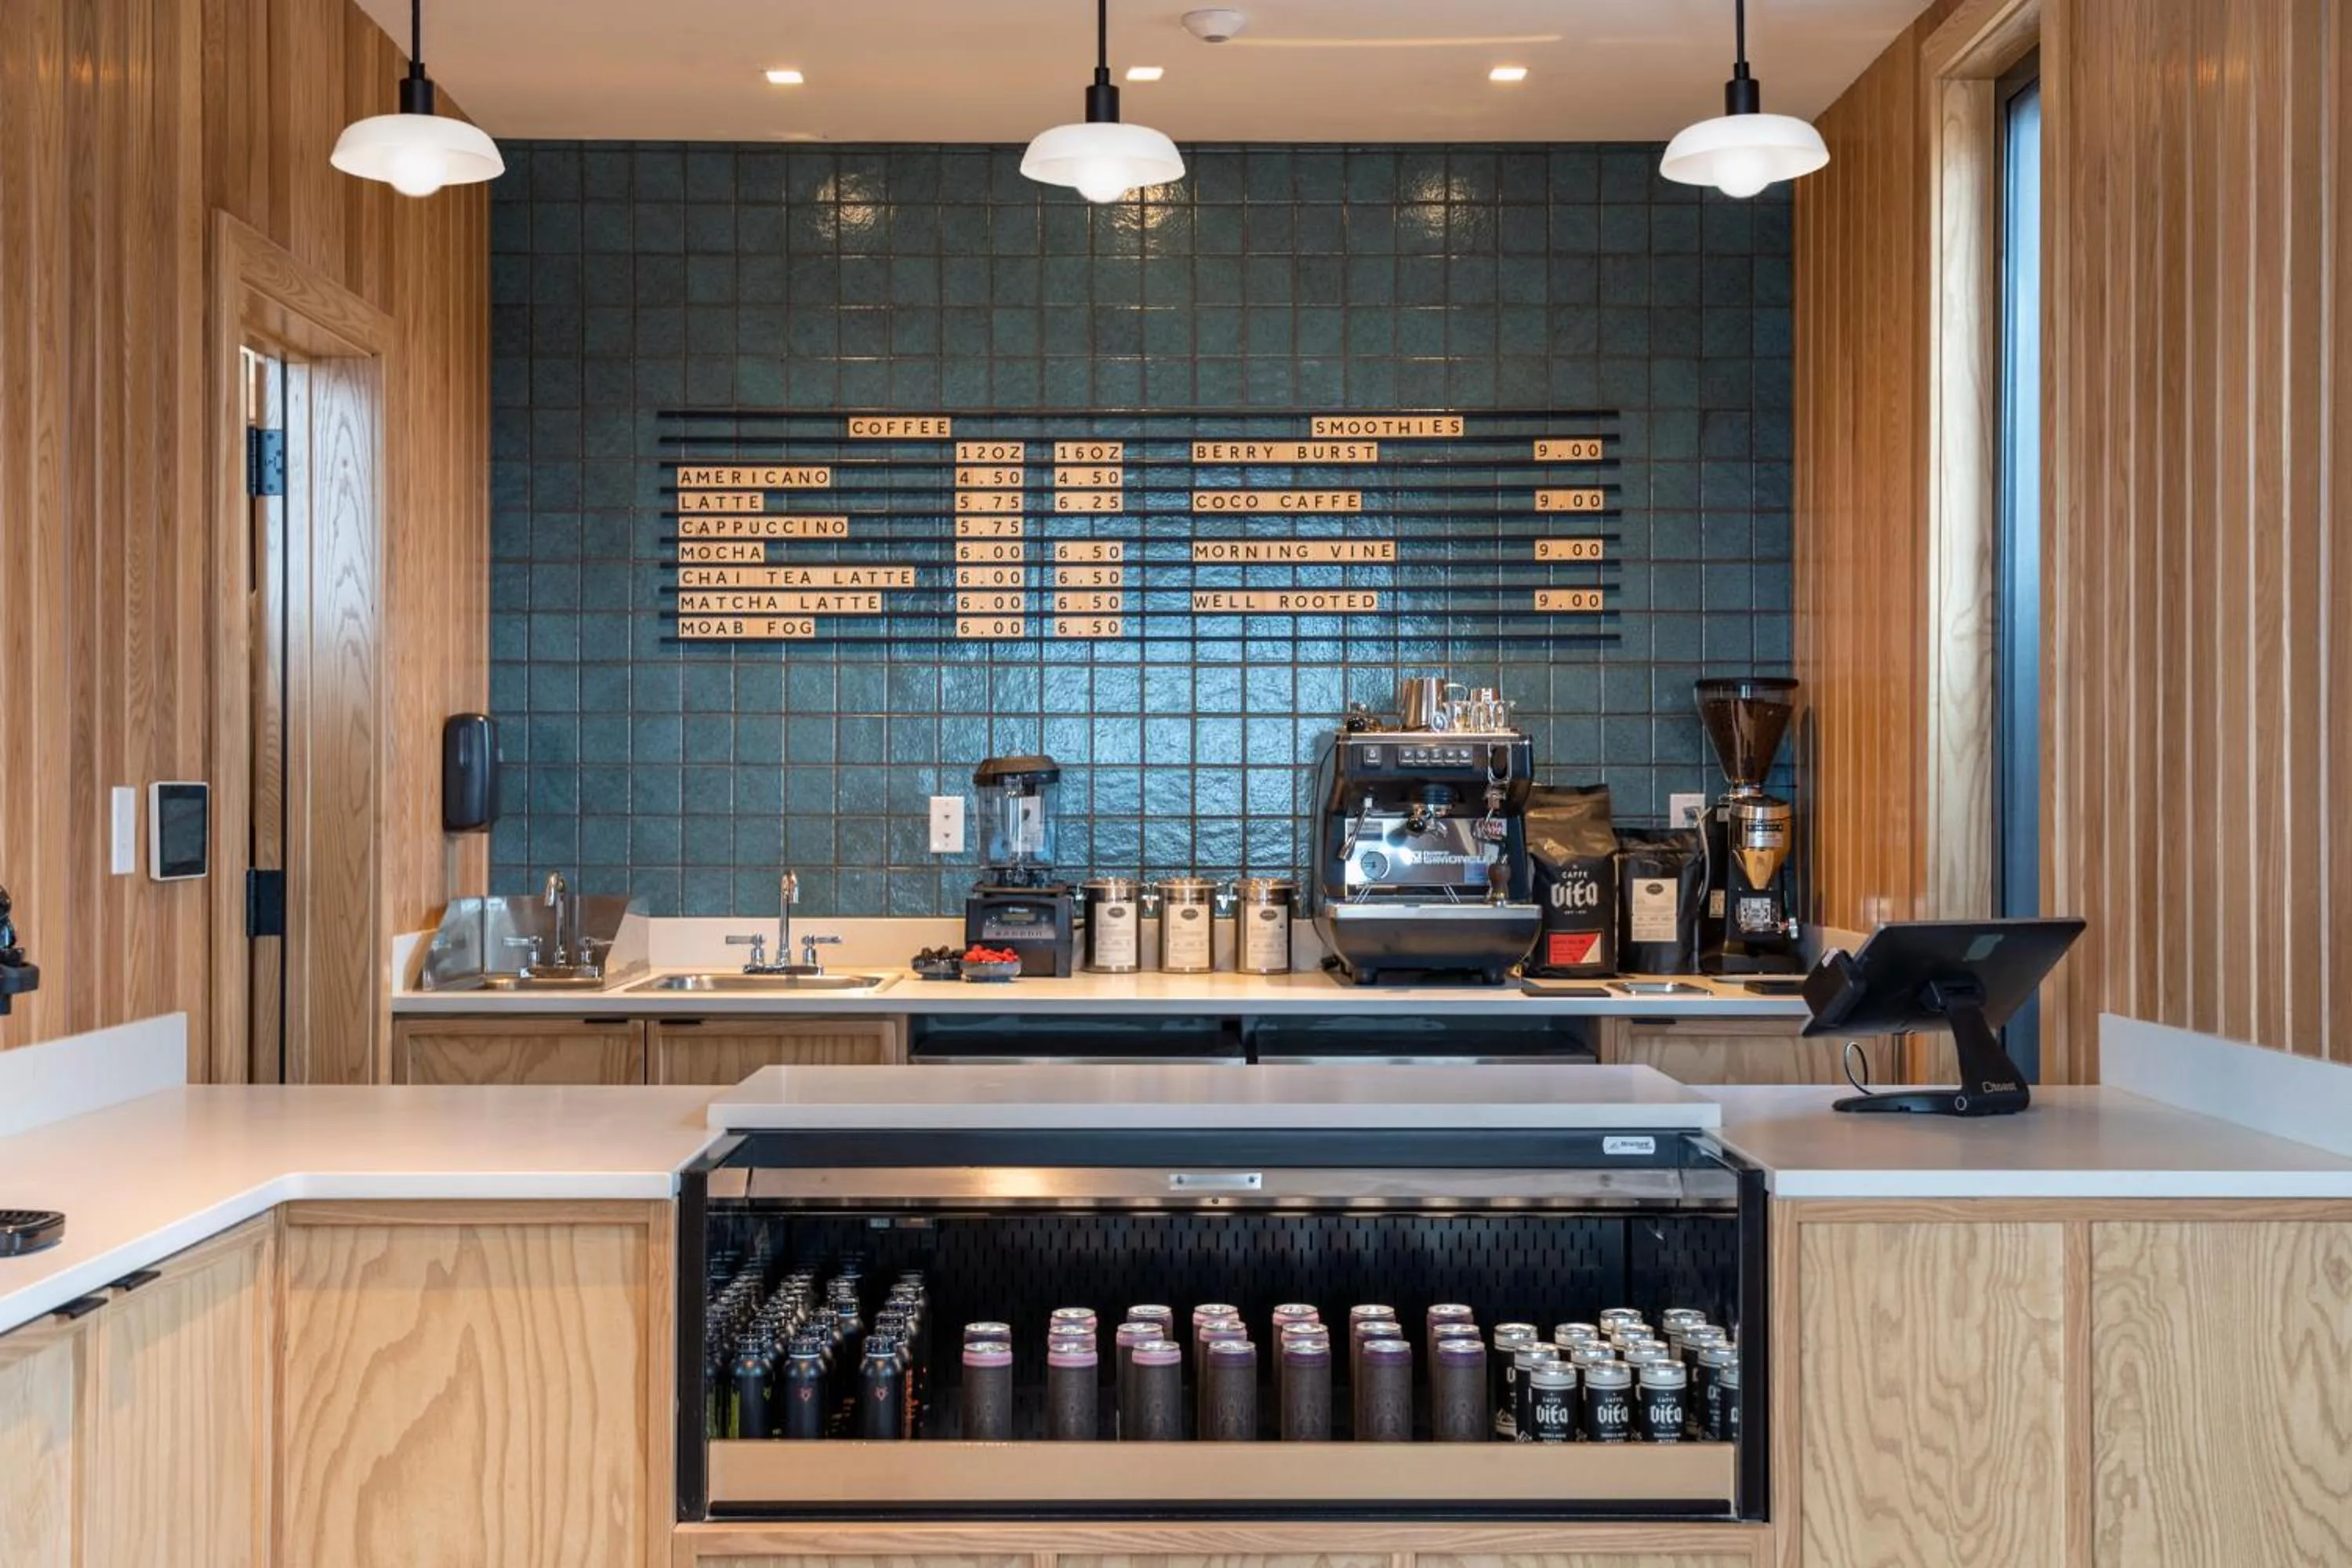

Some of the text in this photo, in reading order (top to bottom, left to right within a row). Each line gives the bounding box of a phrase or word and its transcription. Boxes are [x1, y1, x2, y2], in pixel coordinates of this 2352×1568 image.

[852, 420, 947, 436] COFFEE
[1316, 419, 1460, 435] SMOOTHIES
[960, 445, 1021, 460] 12OZ
[1059, 445, 1120, 460] 16OZ
[1196, 445, 1374, 459] BERRY BURST
[1538, 443, 1599, 459] 9.00
[680, 470, 828, 485] AMERICANO
[959, 470, 1020, 485] 4.50
[1058, 470, 1119, 485] 4.50
[681, 495, 759, 510] LATTE
[959, 495, 1019, 510] 5.75
[1059, 495, 1119, 510] 6.25
[1195, 494, 1358, 510] COCO CAFFE
[1540, 494, 1601, 509] 9.00
[681, 520, 845, 535] CAPPUCCINO
[960, 520, 1019, 535] 5.75
[681, 545, 761, 561] MOCHA
[960, 545, 1021, 559] 6.00
[1058, 545, 1120, 561] 6.50
[1194, 543, 1391, 559] MORNING VINE
[1539, 543, 1600, 557] 9.00
[682, 570, 910, 585] CHAI TEA LATTE
[960, 570, 1021, 585] 6.00
[1058, 571, 1120, 585] 6.50
[681, 595, 877, 610] MATCHA LATTE
[960, 595, 1021, 610] 6.00
[1058, 595, 1119, 610] 6.50
[1192, 593, 1374, 609] WELL ROOTED
[1539, 593, 1599, 608] 9.00
[681, 620, 812, 635] MOAB FOG
[960, 620, 1021, 635] 6.00
[1058, 620, 1119, 635] 6.50
